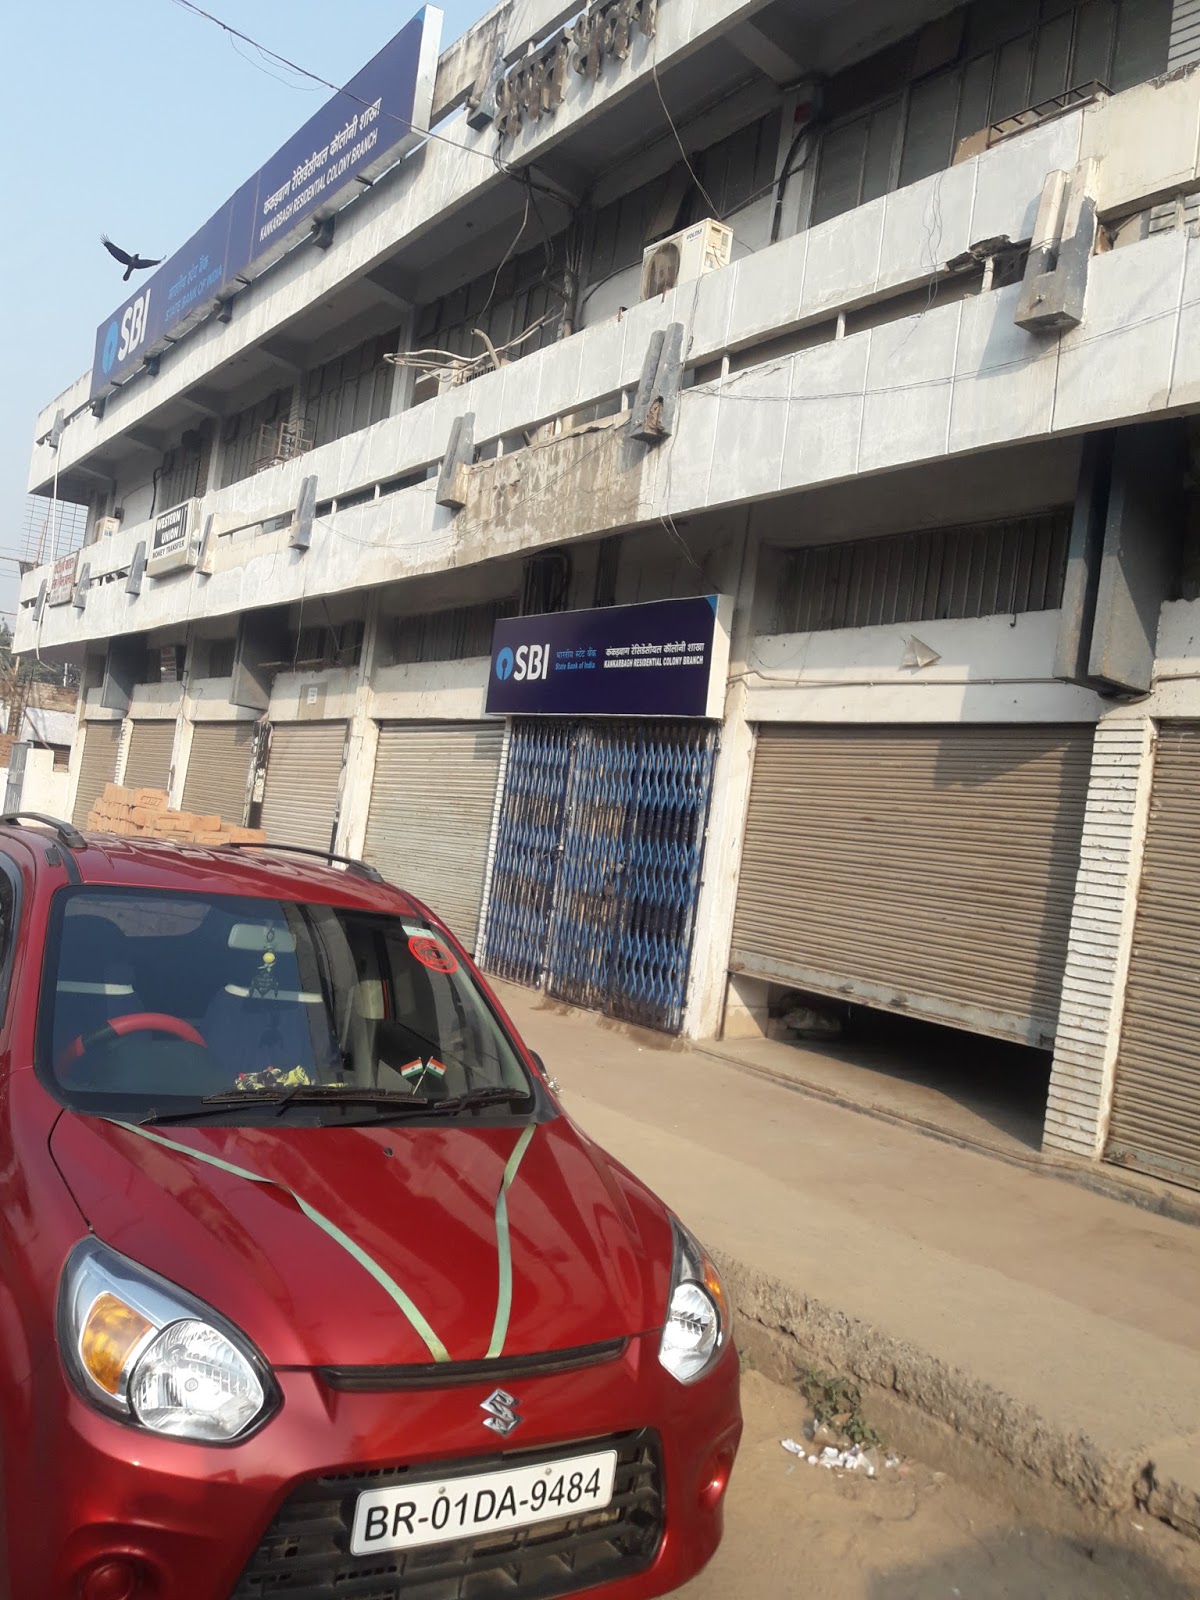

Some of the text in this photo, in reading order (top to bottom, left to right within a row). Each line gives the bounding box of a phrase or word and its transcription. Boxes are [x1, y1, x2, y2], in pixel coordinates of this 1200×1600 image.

[329, 115, 358, 157] कॉलोनी
[259, 128, 378, 242] KANKARBAGH RESIDENTIAL COLONY BRANCH
[117, 288, 151, 361] SBI
[157, 509, 181, 531] WESTERN
[161, 526, 179, 544] UNION
[513, 643, 550, 681] SBI
[604, 655, 704, 668] KANKARBAGH RESIDENTIAL COLONY BRANCH
[664, 641, 686, 653] कॉलोनी
[687, 642, 705, 652] शाखा
[555, 662, 566, 671] State
[567, 662, 578, 670] Bank
[584, 661, 595, 669] India
[364, 1467, 601, 1542] BR-01DA-9484
